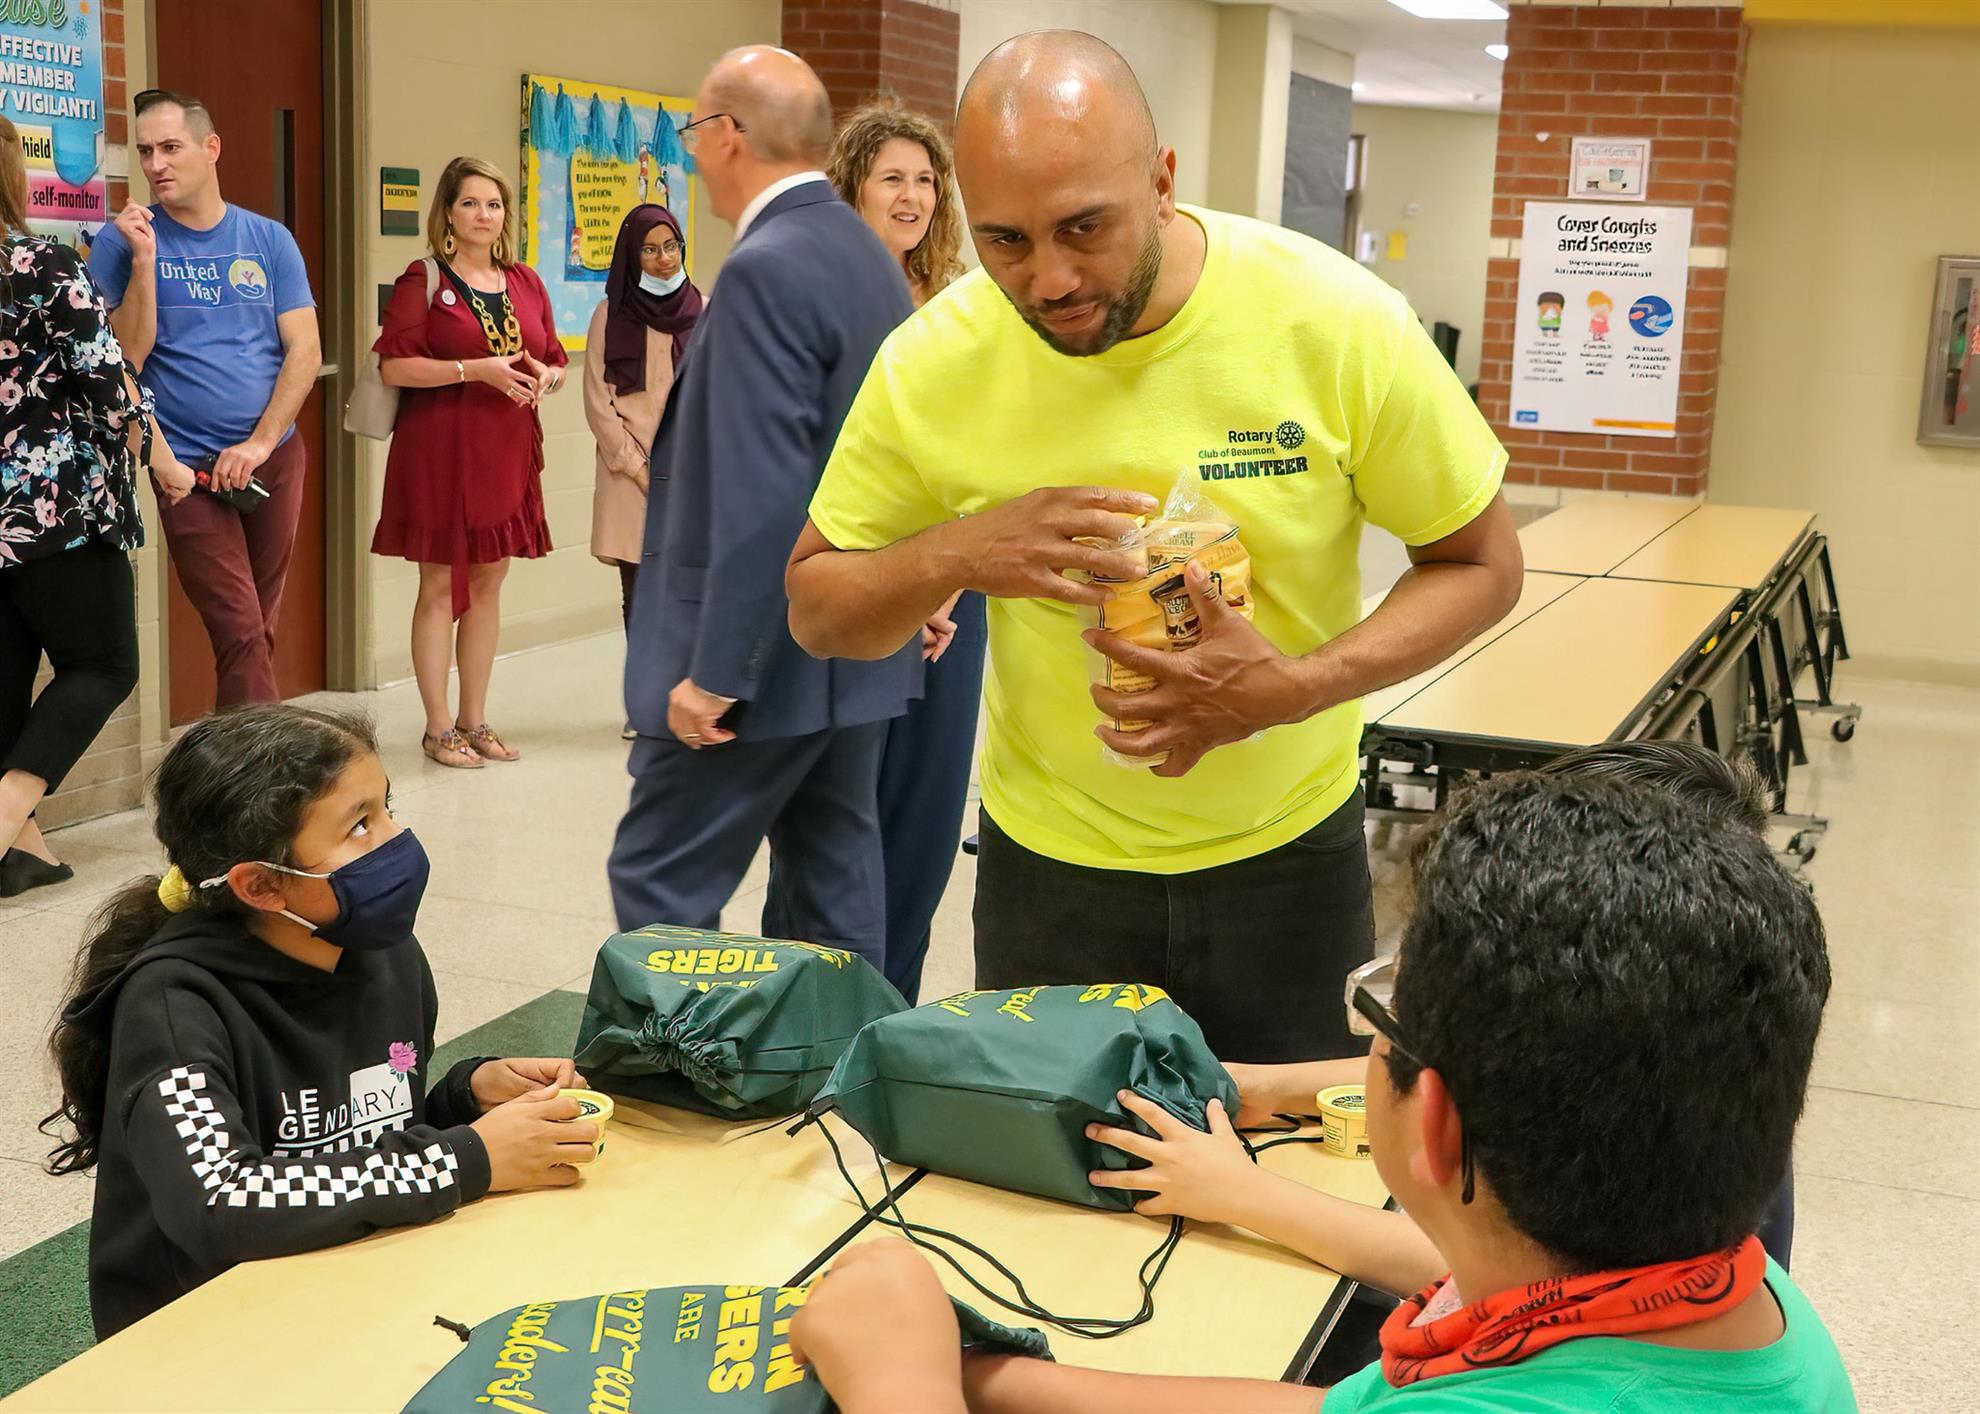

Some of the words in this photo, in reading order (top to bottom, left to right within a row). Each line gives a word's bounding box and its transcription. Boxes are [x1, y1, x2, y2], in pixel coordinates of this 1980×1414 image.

[0, 34, 83, 67] FFECTIVE
[11, 90, 97, 121] VIGILANT!
[33, 186, 99, 209] self-monitor
[1557, 214, 1599, 233] Cover
[1601, 216, 1657, 239] Coughs
[1558, 235, 1588, 252] and
[1590, 234, 1652, 254] Sneezes
[159, 260, 220, 281] United
[185, 281, 222, 305] Way
[1228, 430, 1274, 444] Rotary
[1198, 448, 1219, 459] Club
[1220, 448, 1230, 458] of
[1231, 446, 1276, 457] Beaumont
[1199, 456, 1309, 481] VOLUNTEER
[638, 949, 780, 975] TIGERS
[674, 1291, 707, 1345] ARE
